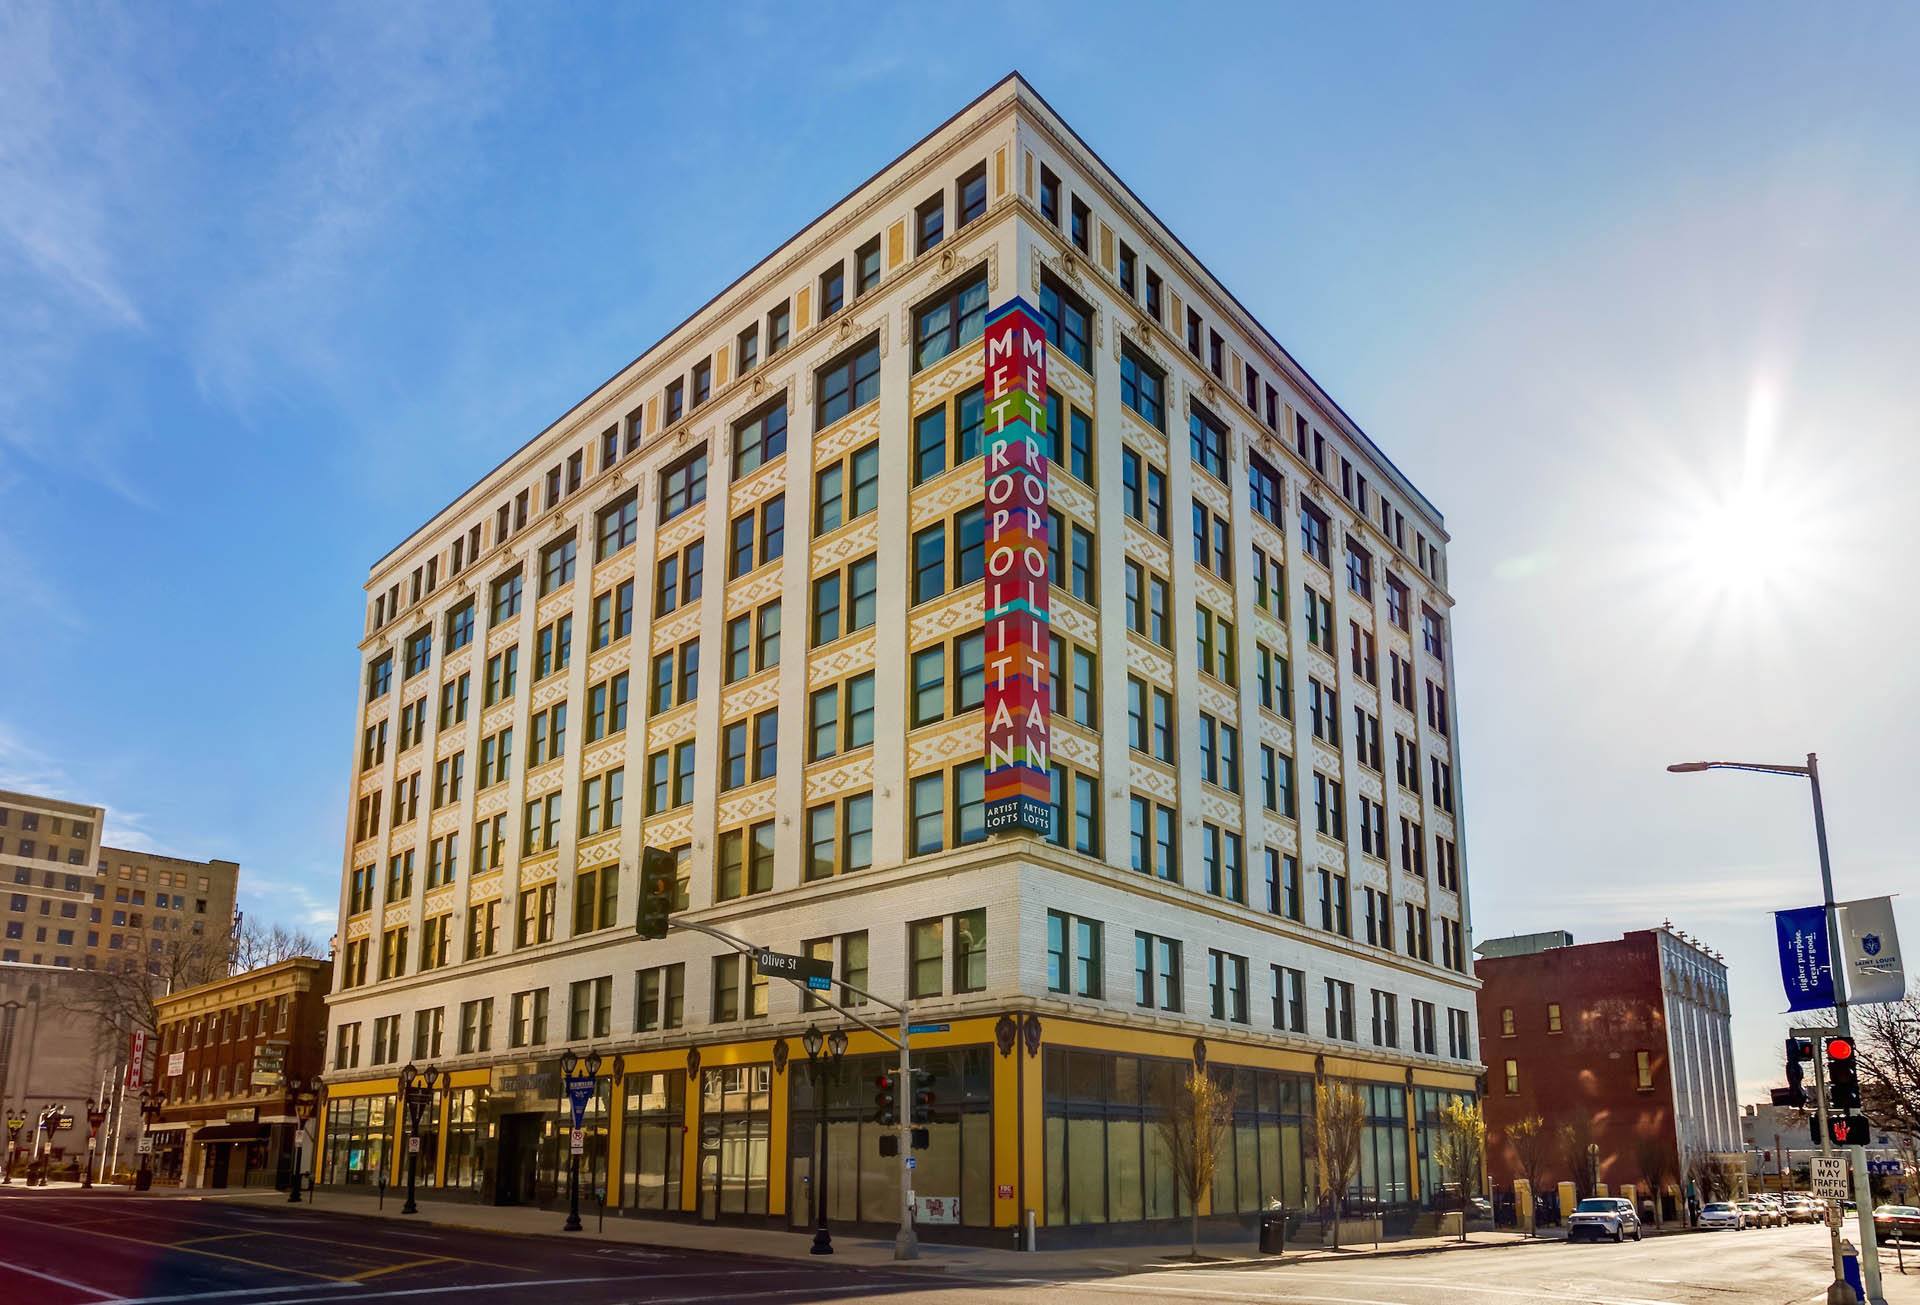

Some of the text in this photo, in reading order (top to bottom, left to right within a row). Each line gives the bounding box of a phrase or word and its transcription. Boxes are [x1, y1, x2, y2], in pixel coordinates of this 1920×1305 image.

[989, 327, 1014, 774] METROPOLITAN
[1023, 327, 1046, 775] METROPOLITAN
[987, 802, 1018, 817] ARTIST
[1023, 802, 1049, 817] ARTIST
[987, 813, 1018, 828] LOFTS
[1023, 813, 1049, 829] LOFTS
[761, 953, 797, 970] Olive St
[1798, 965, 1809, 991] Higher
[1808, 955, 1818, 986] Greater
[131, 1033, 142, 1089] LUCHA
[1818, 1160, 1840, 1168] TWO
[1817, 1169, 1840, 1178] WAY
[1814, 1179, 1847, 1188] TRAFFIC
[1816, 1189, 1845, 1198] AHEAD
